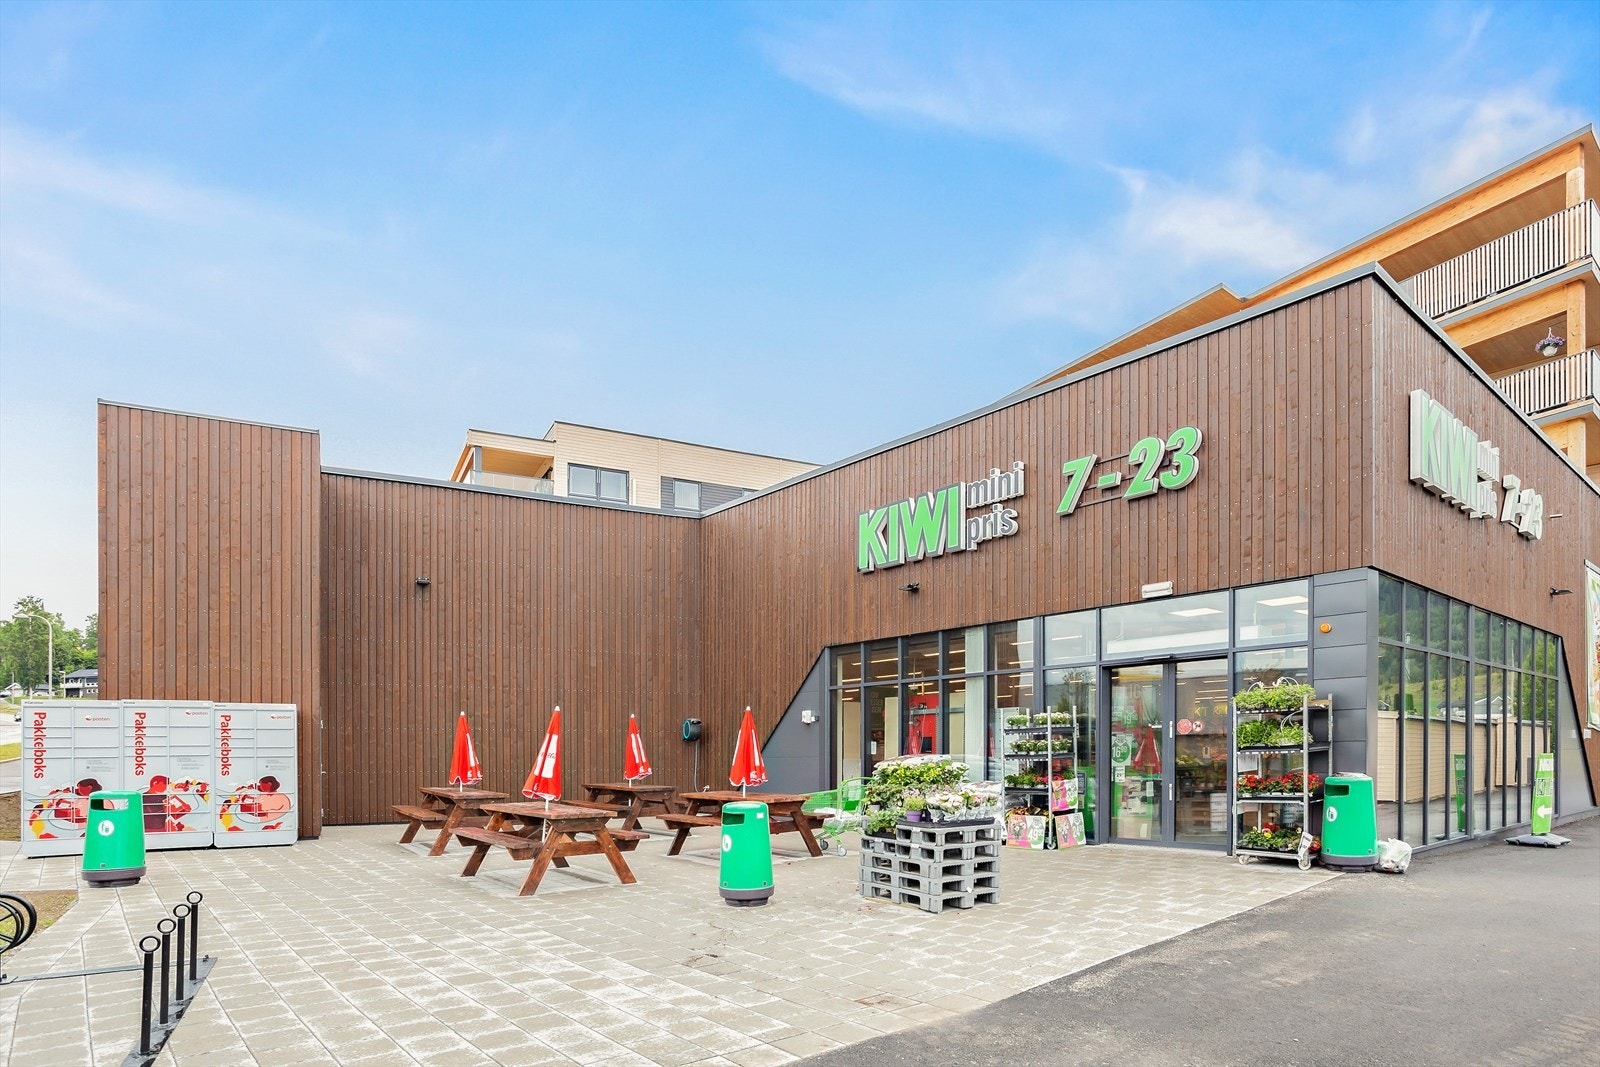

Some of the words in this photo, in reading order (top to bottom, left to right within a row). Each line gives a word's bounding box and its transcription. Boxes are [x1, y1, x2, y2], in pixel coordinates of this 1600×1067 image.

[1056, 426, 1203, 516] 7-23
[1410, 389, 1478, 512] KIWI
[966, 461, 1025, 509] mini
[857, 481, 966, 573] KIWI
[966, 503, 1019, 551] pris
[33, 712, 47, 779] Pakkeboks
[134, 712, 147, 776] Pakkeboks
[220, 715, 232, 777] Pakkeboks
